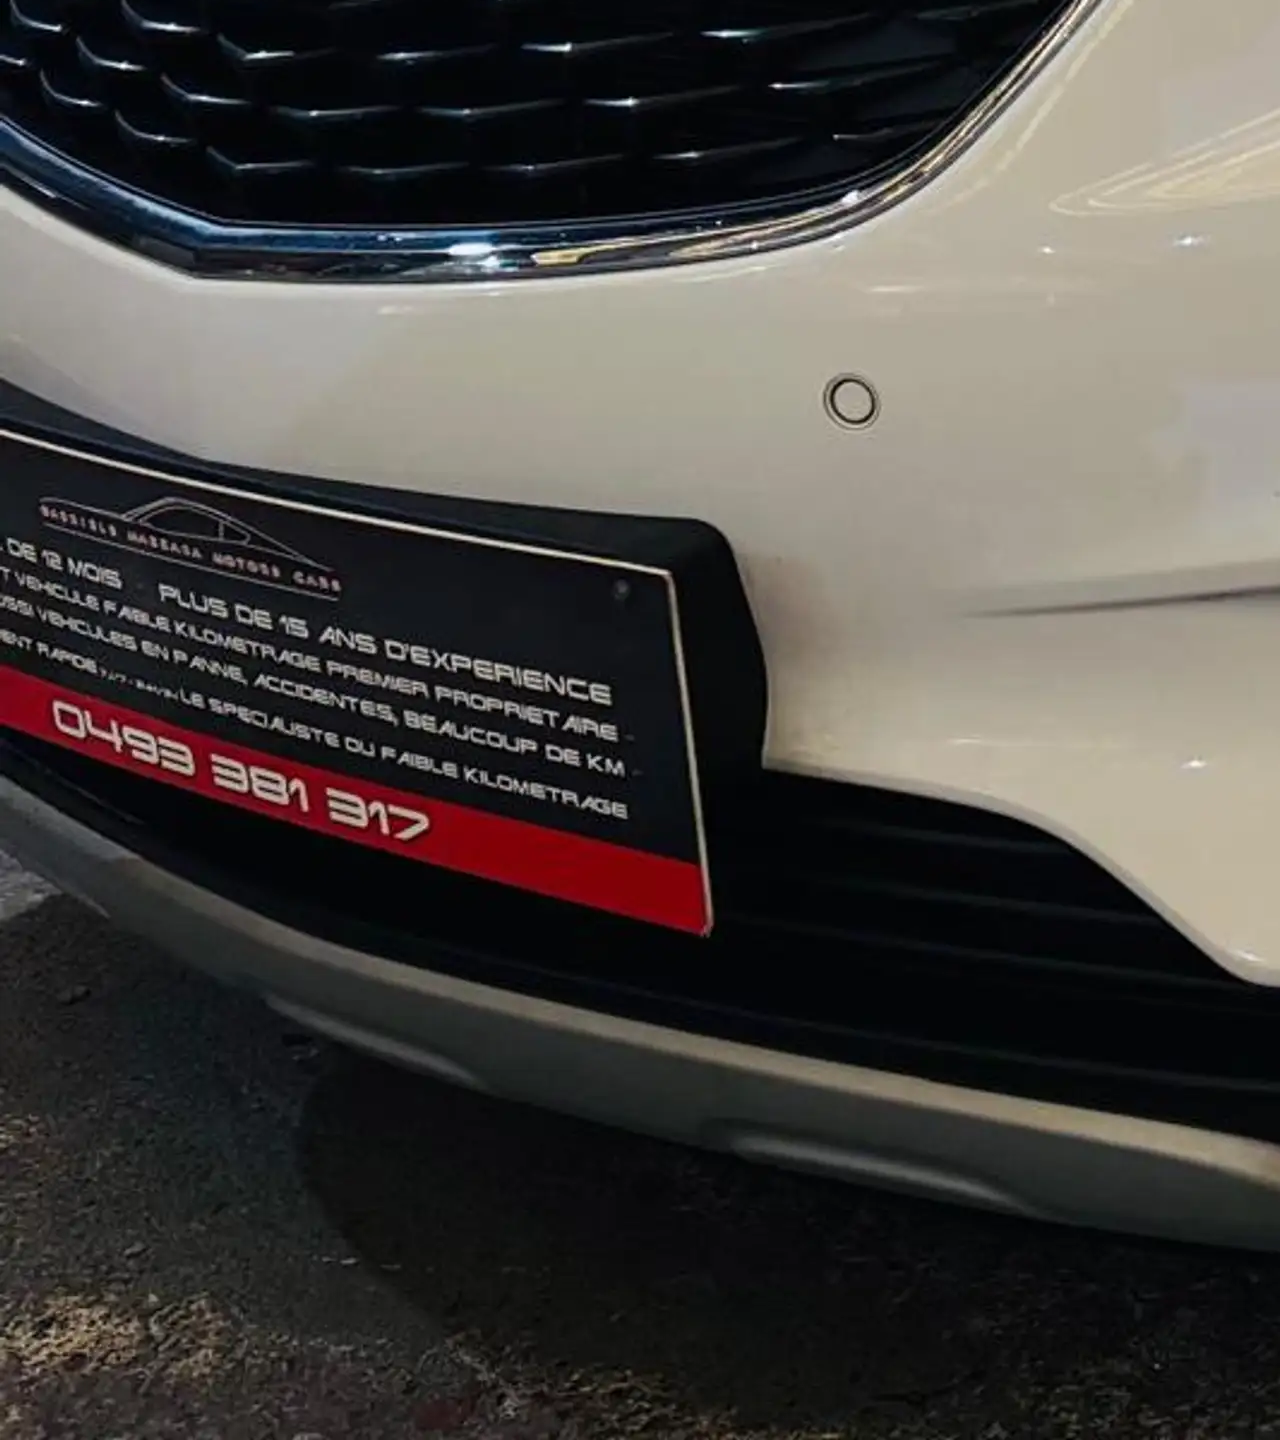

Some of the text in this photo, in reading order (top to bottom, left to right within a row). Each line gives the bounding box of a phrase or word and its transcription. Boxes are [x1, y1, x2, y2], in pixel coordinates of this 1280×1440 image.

[7, 537, 613, 706] DE 12 MOIS PLUS DE 15 ANS D'EXPERIENCE
[174, 620, 322, 673] KILOMETRAGE
[326, 659, 430, 698] PREMIER
[52, 699, 430, 841] 0493 381 317
[141, 640, 169, 662] EN
[253, 673, 399, 727] ACCIDENTES,
[403, 710, 538, 754] BEAUCOUP
[545, 743, 581, 767] DE
[586, 753, 626, 777] KM
[344, 735, 376, 758] DU
[463, 765, 629, 820] KILOMETRAGE
